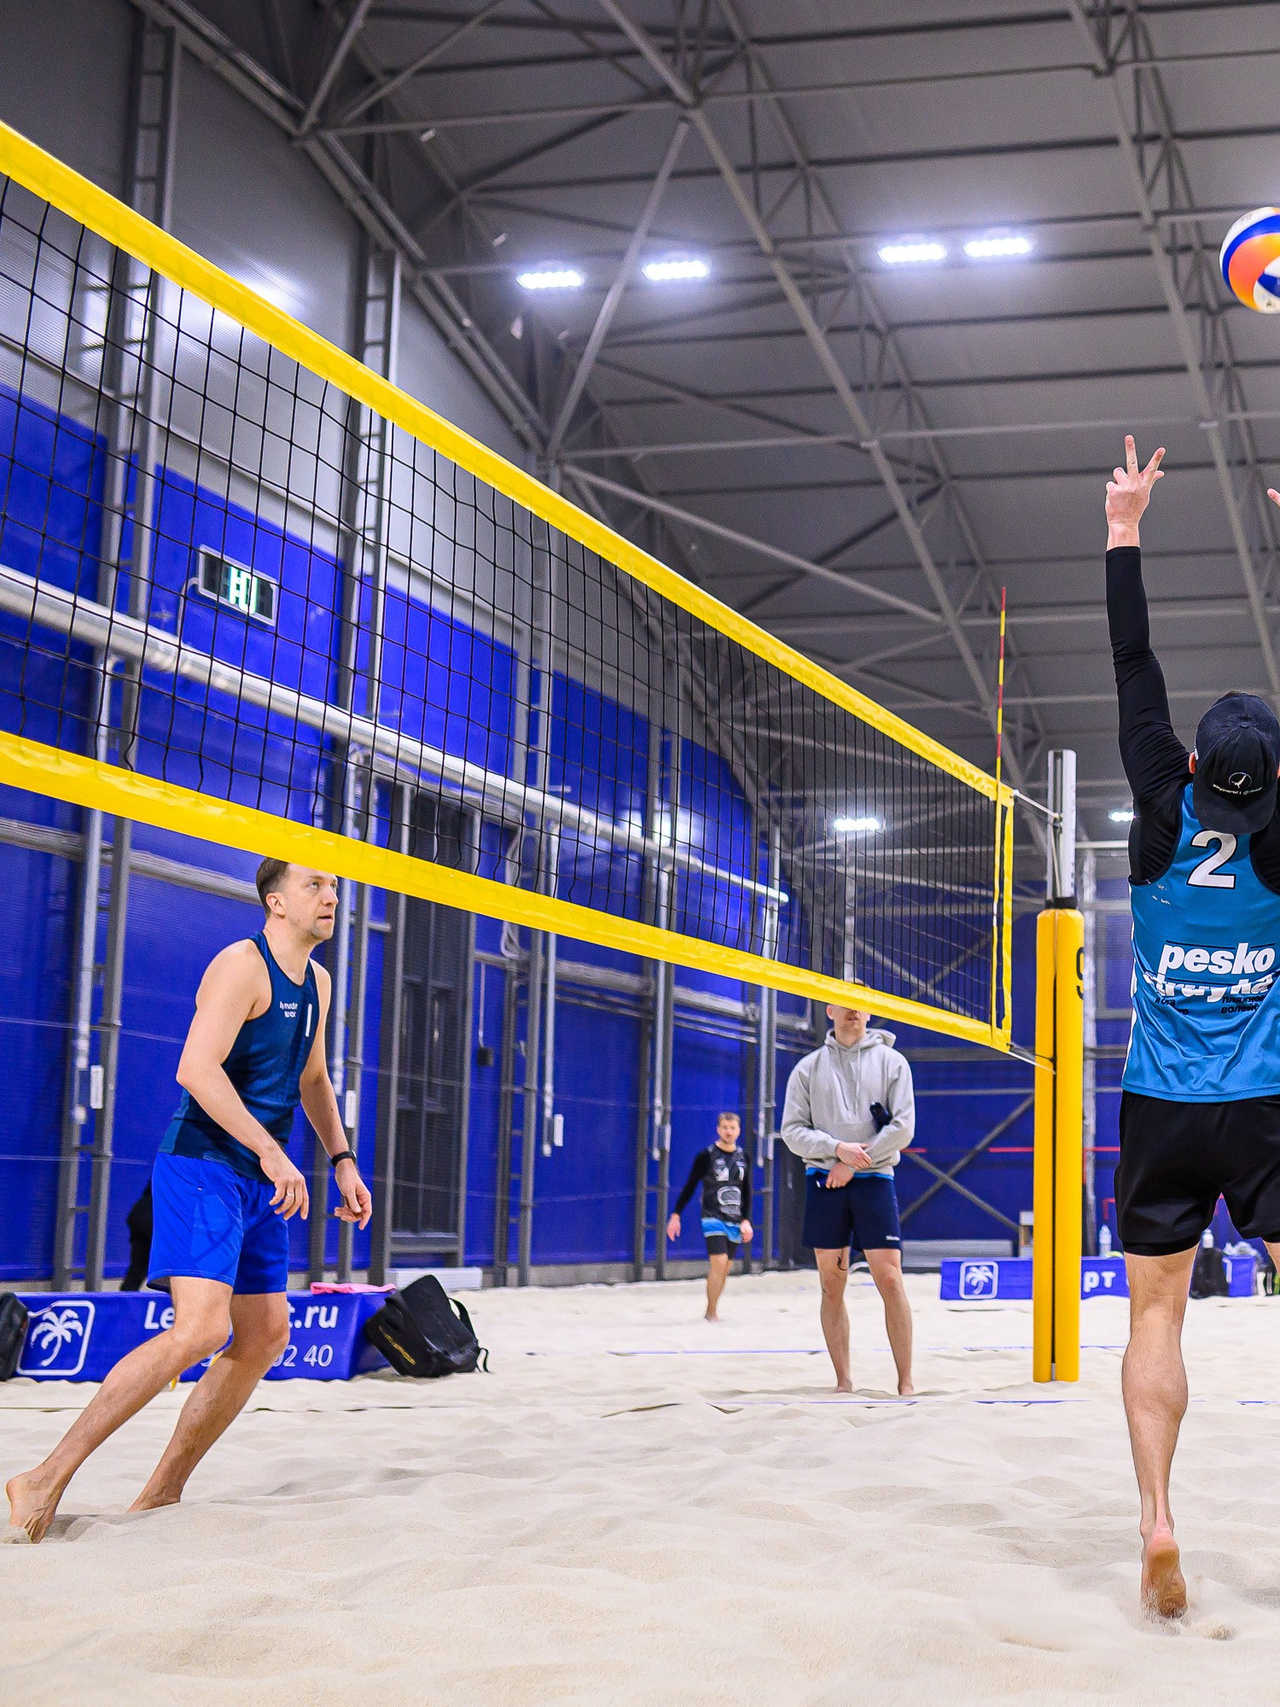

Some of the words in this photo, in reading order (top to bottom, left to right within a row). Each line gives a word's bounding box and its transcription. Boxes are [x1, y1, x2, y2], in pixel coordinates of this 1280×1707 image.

[1187, 829, 1236, 889] 2
[1157, 942, 1276, 978] pesko
[303, 1344, 333, 1367] 40
